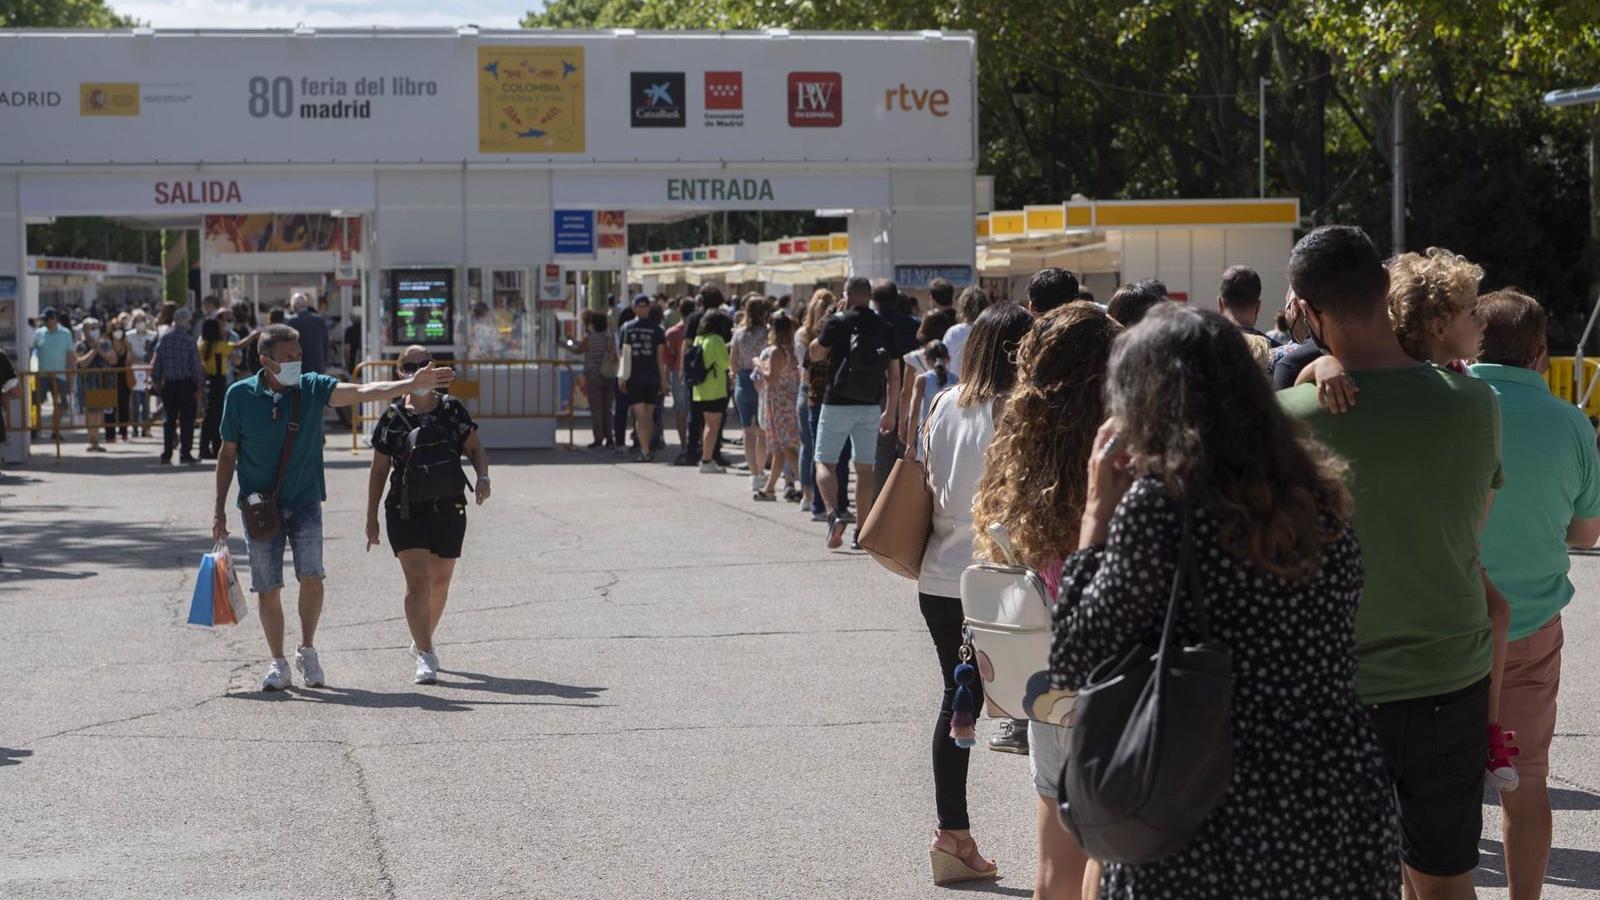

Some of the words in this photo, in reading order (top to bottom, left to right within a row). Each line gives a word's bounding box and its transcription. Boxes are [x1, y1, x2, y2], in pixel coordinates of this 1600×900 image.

[248, 76, 294, 118] 80
[300, 77, 347, 96] feria
[355, 77, 384, 96] del
[392, 77, 438, 96] libro
[502, 83, 561, 93] COLOMBIA
[796, 82, 835, 111] PW
[300, 101, 370, 119] madrid
[885, 83, 950, 117] rtve
[636, 108, 680, 119] CaixaBank
[155, 181, 243, 204] SALIDA
[667, 179, 775, 201] ENTRADA
